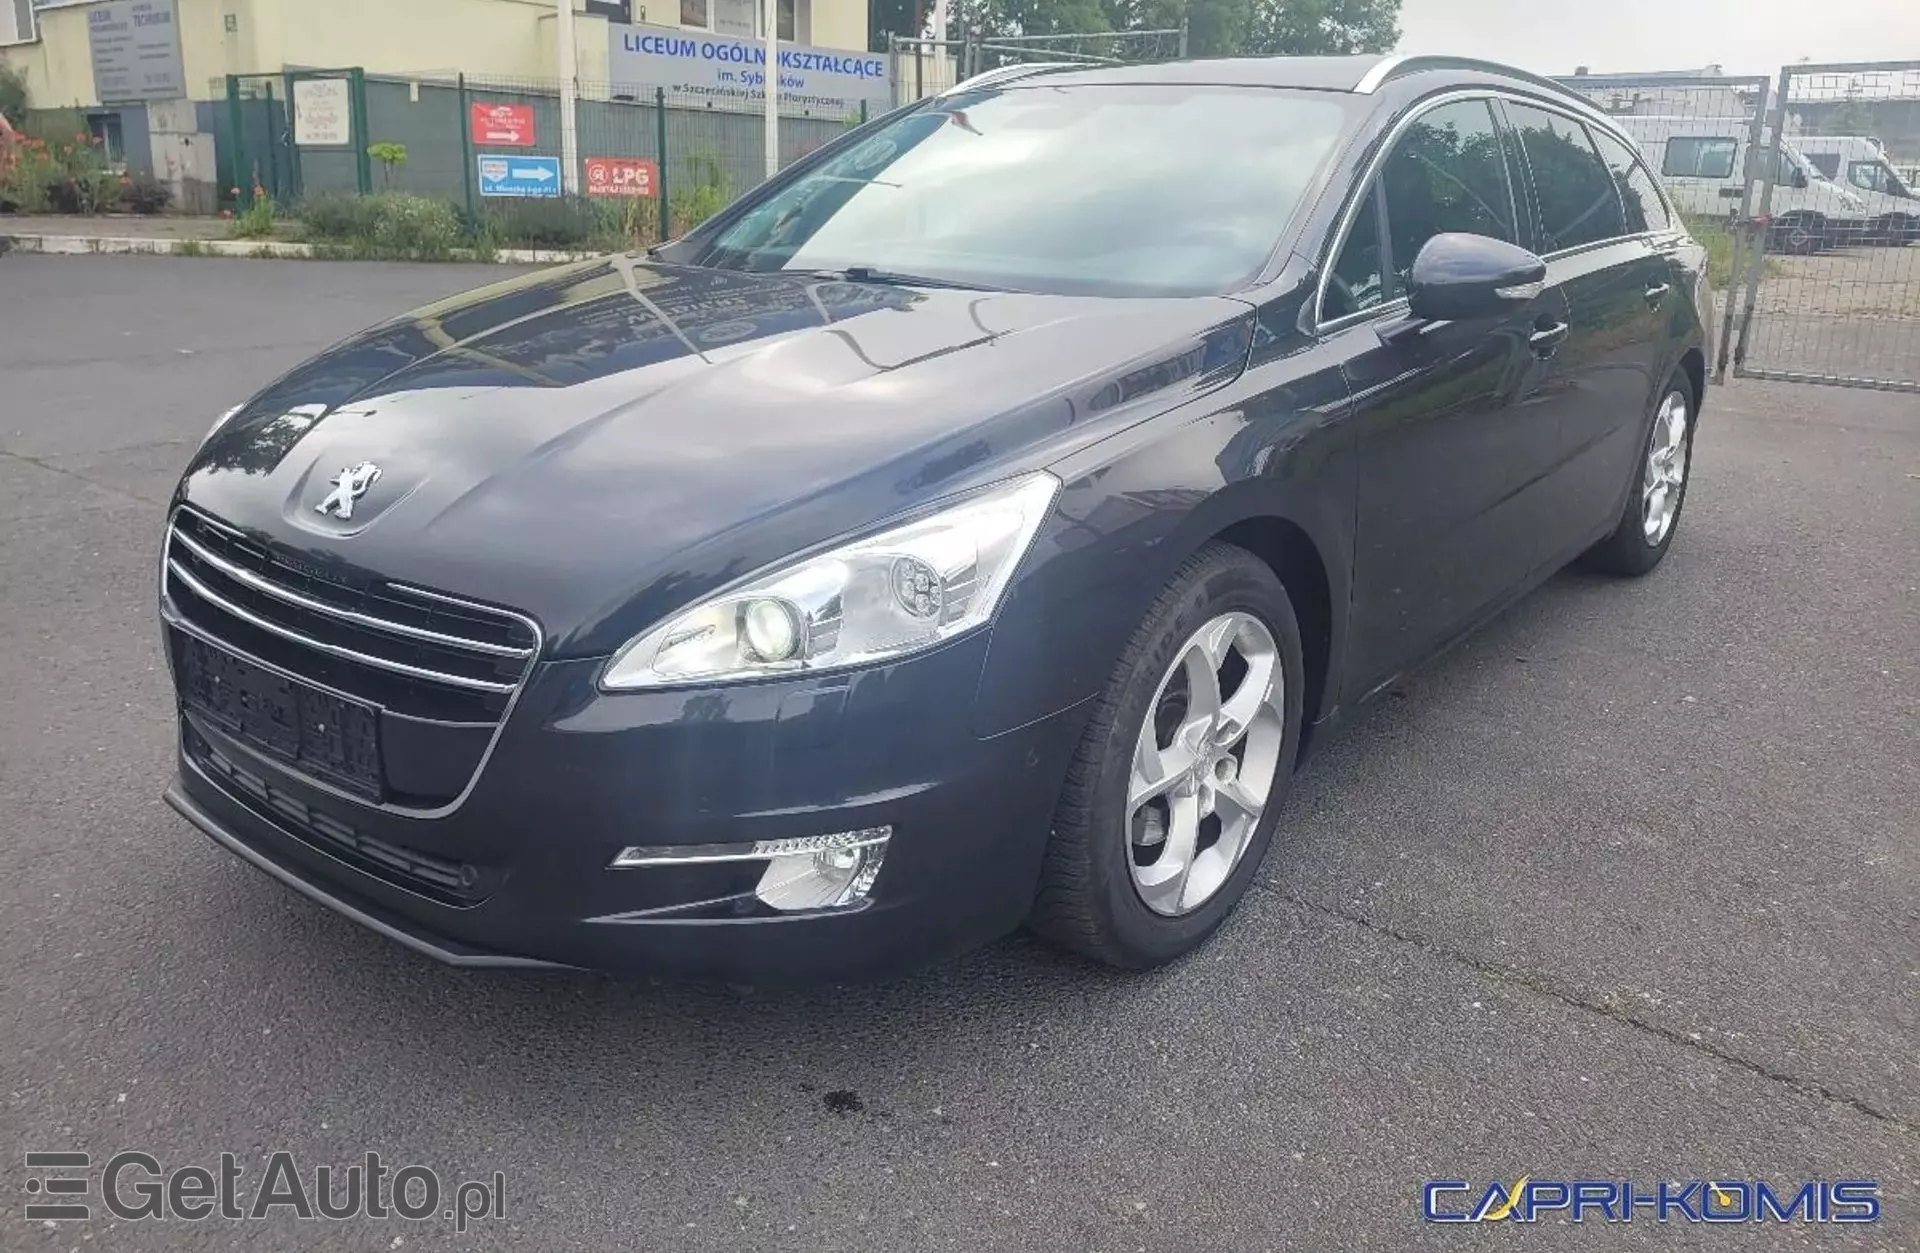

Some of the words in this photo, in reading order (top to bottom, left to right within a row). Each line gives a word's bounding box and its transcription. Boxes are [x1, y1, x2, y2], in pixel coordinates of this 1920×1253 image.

[624, 33, 696, 58] LICEUM
[702, 41, 883, 80] OGÓLNKSZTAŁCĄCE
[717, 68, 737, 82] im.
[612, 167, 649, 185] LPG
